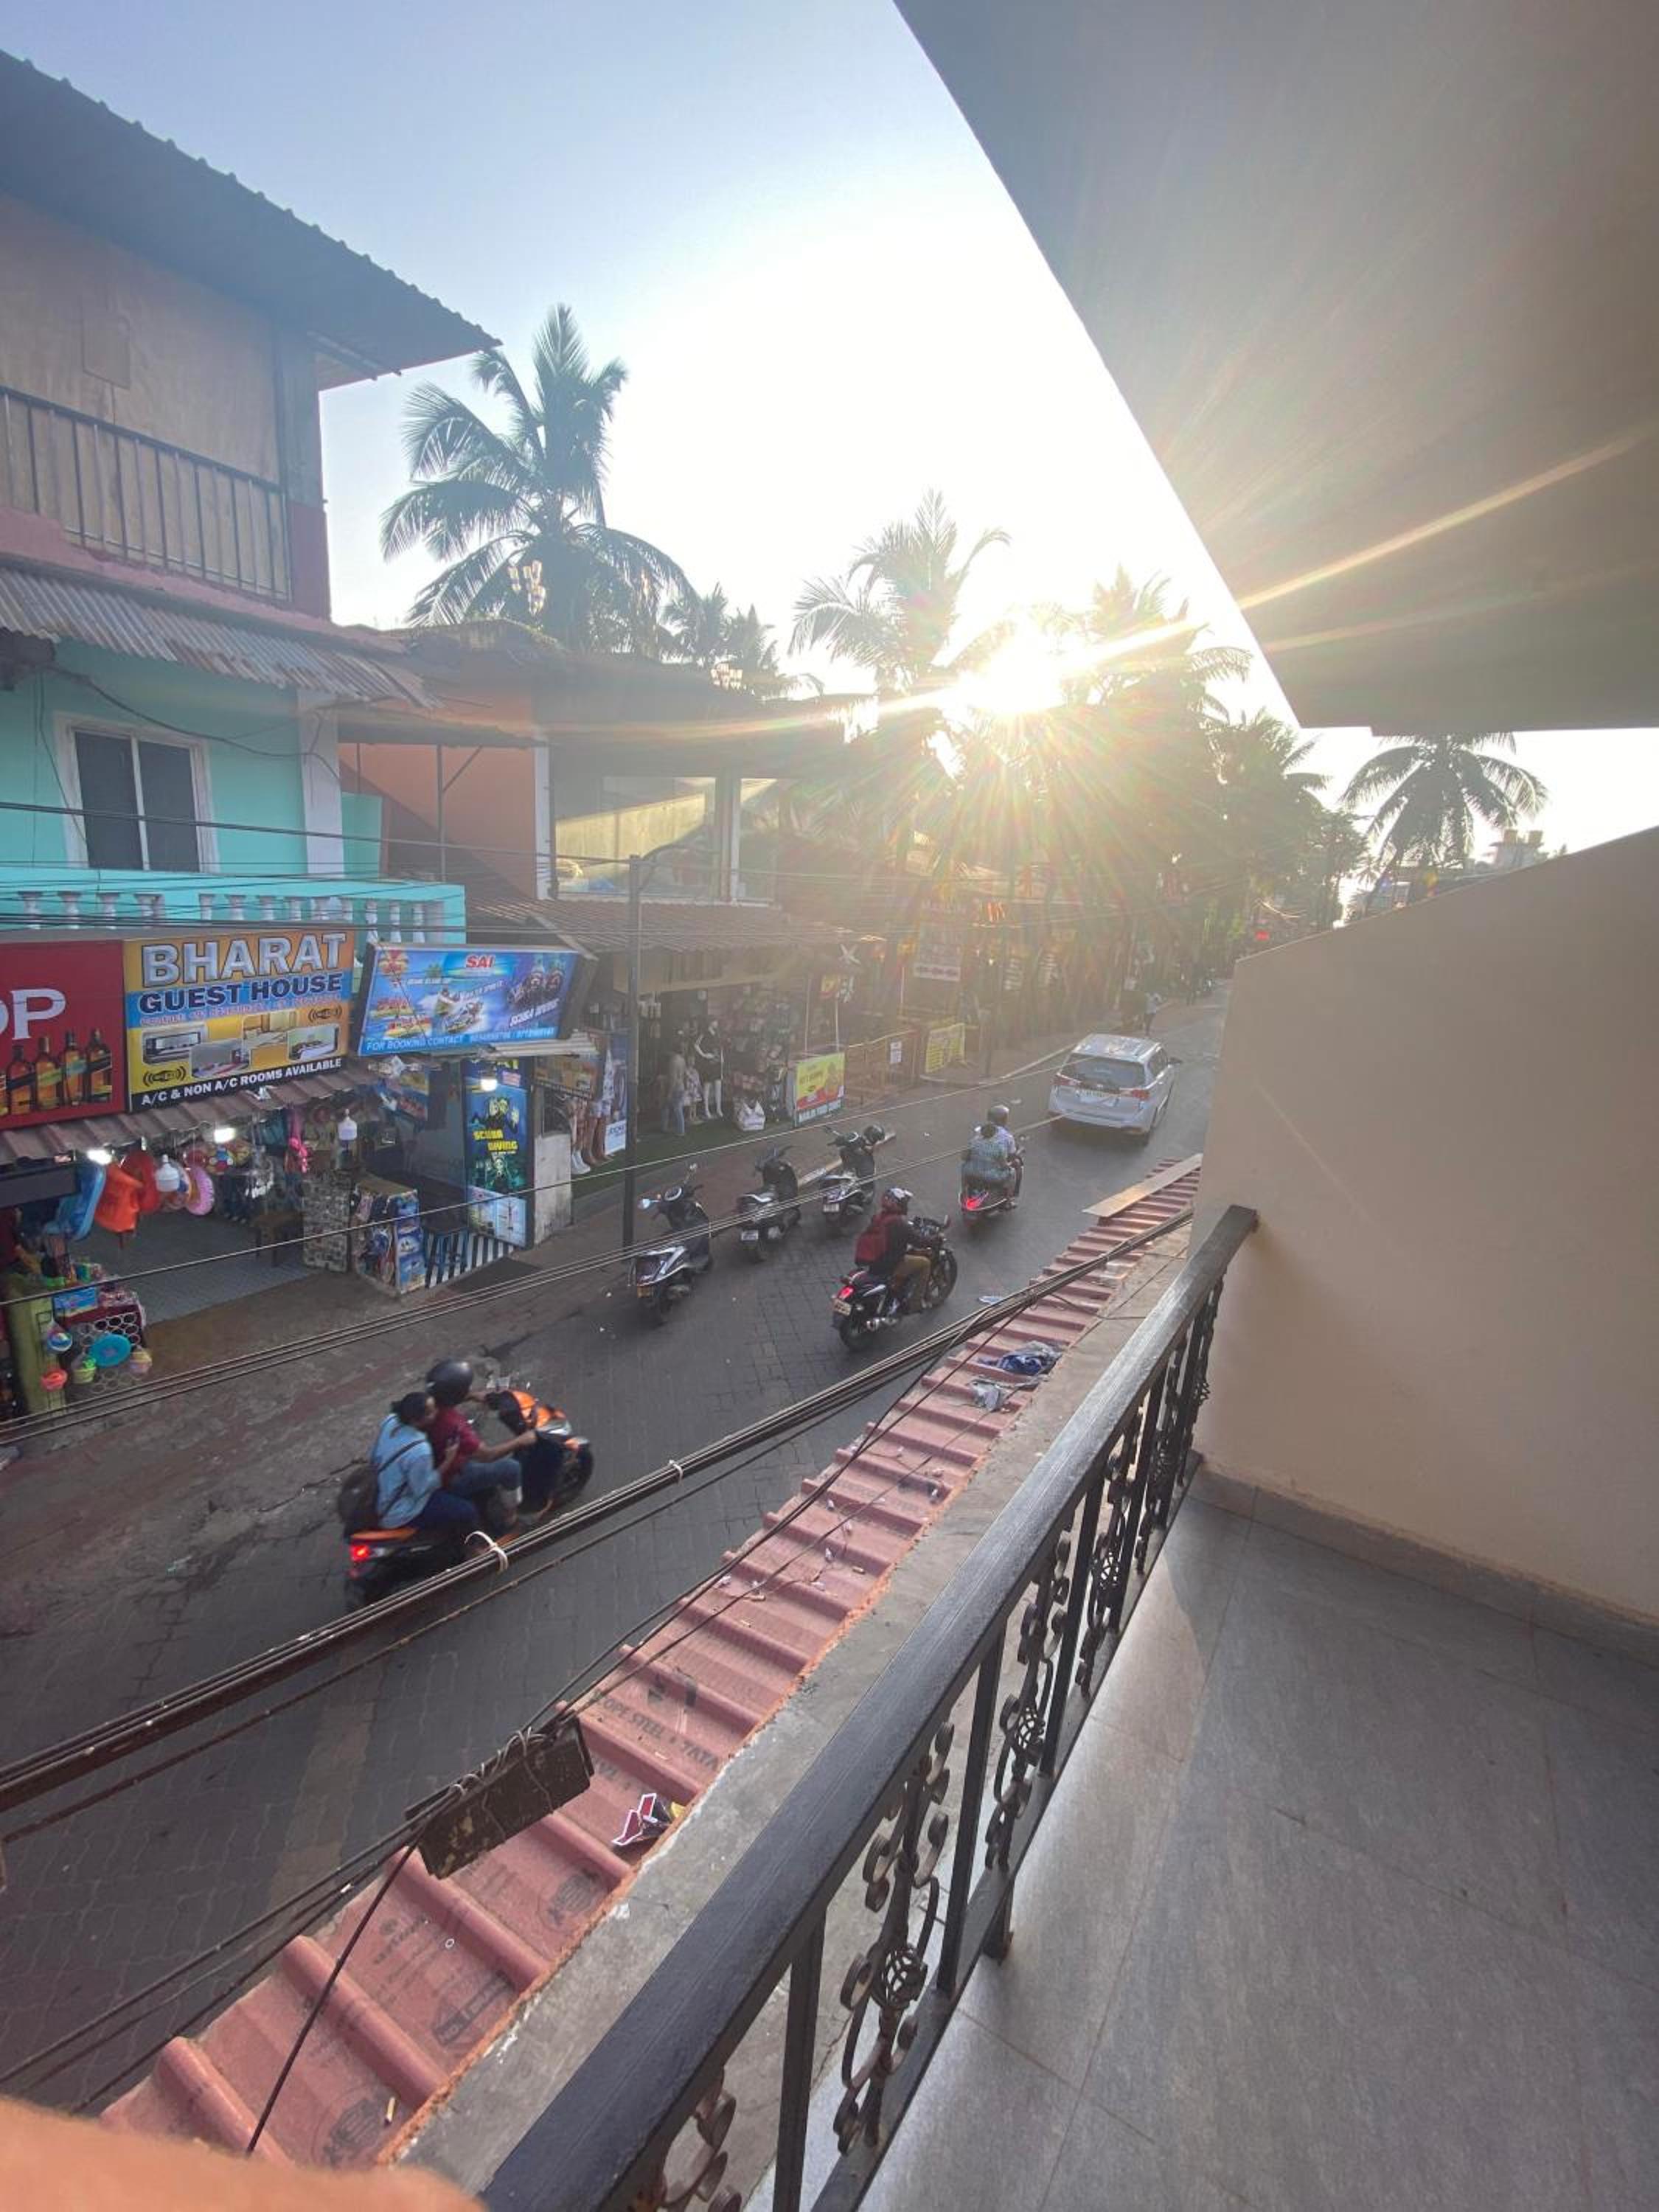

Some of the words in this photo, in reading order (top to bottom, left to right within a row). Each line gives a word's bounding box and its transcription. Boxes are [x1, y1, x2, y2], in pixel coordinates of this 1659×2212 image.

[142, 933, 347, 988] BHARAT
[465, 954, 495, 969] SAI
[139, 984, 242, 1015] GUEST
[251, 973, 344, 1001] HOUSE
[0, 988, 66, 1040] P
[366, 1041, 386, 1051] FOR
[387, 1038, 427, 1050] BOOKING
[428, 1035, 462, 1047] CONTACT
[141, 1093, 167, 1106] A/C
[170, 1089, 182, 1099] &
[184, 1082, 212, 1097] NON
[215, 1077, 238, 1091] A/C
[240, 1068, 283, 1085] ROOMS
[285, 1057, 343, 1079] AVAILABLE
[473, 1129, 504, 1141] SCUBA
[487, 1140, 518, 1152] DIVING
